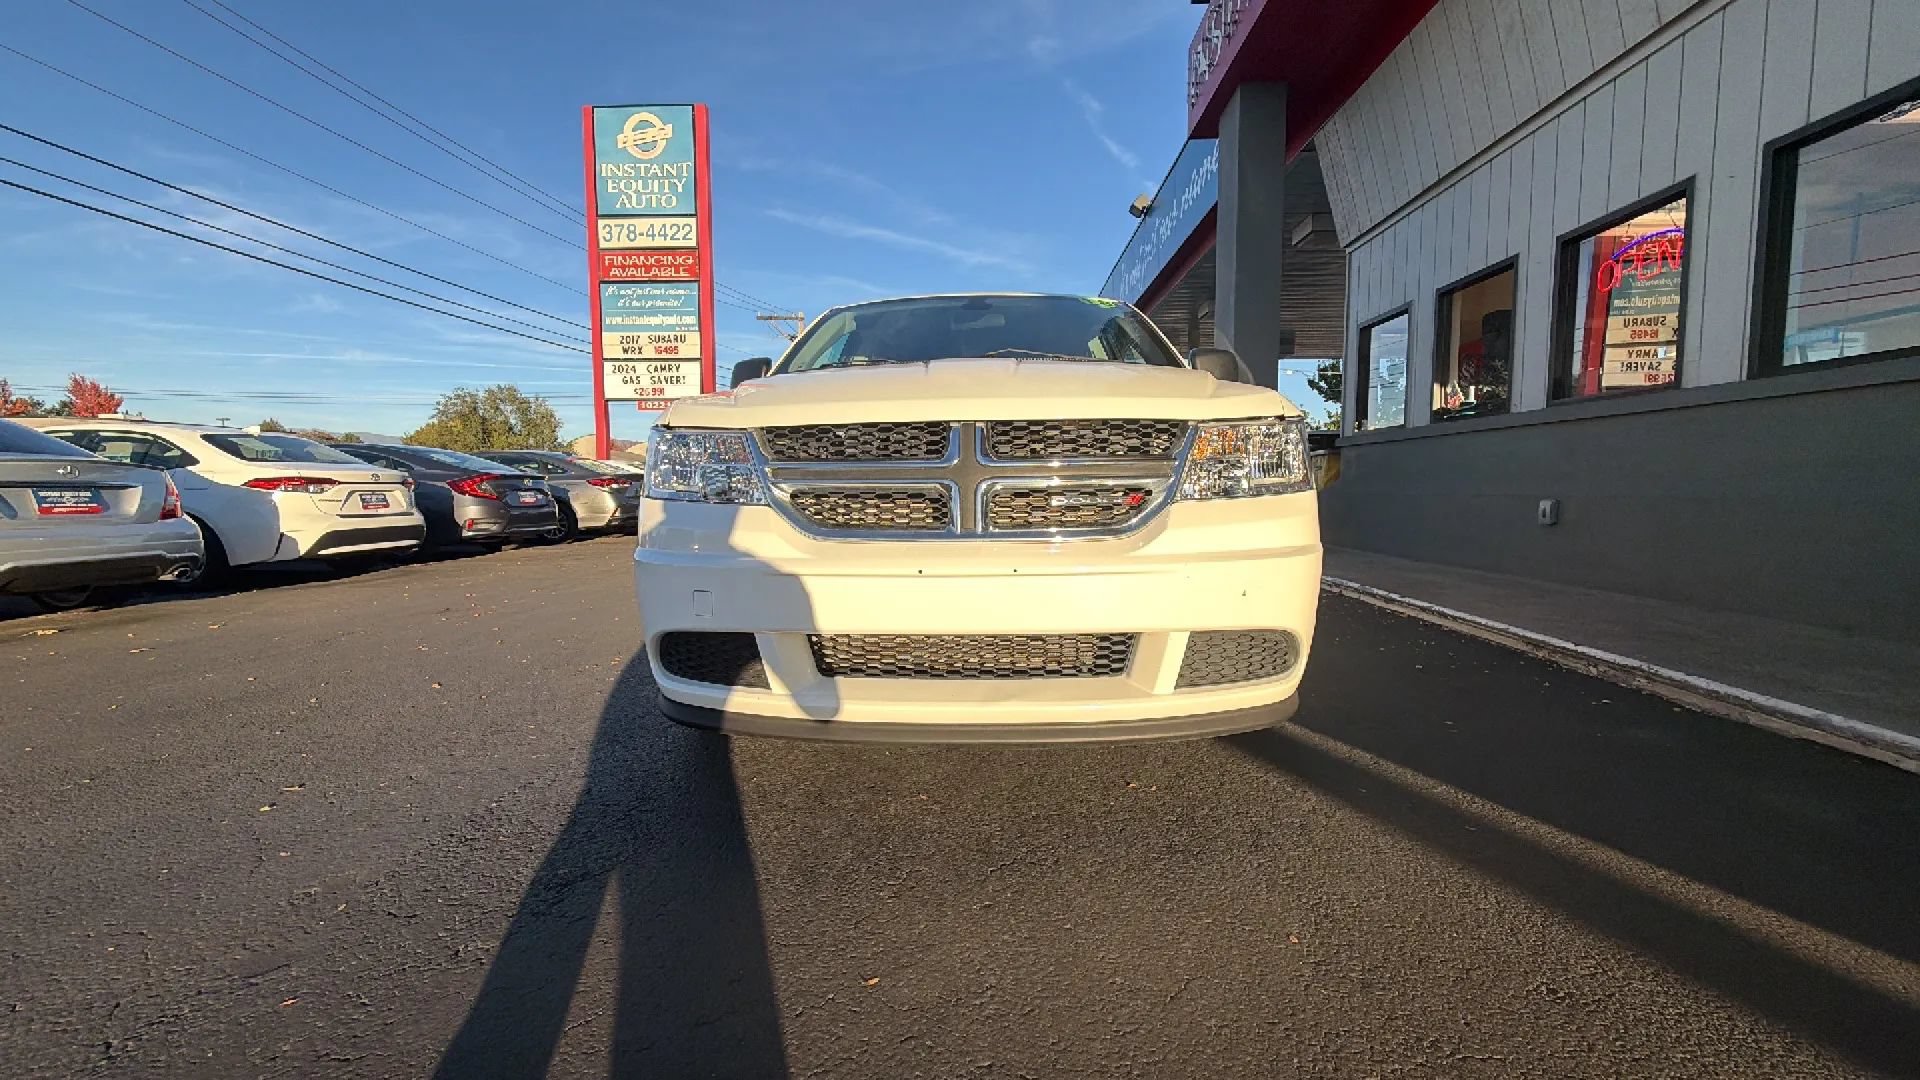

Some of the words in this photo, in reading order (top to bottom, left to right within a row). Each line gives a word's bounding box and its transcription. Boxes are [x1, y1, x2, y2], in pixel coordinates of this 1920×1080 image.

[600, 162, 692, 177] INSTANT
[606, 178, 686, 194] EQUITY
[615, 193, 677, 208] AUTO
[602, 223, 693, 242] 378-4422
[604, 255, 695, 266] FINANCING
[1598, 233, 1683, 292] OPEN
[609, 266, 691, 277] AVAILABLE
[619, 335, 641, 345] 2017
[648, 334, 686, 344] SUBARU
[622, 346, 643, 355] WRX
[654, 345, 679, 355] 16495
[611, 364, 637, 374] 2024
[646, 363, 681, 374] CAMRY
[622, 376, 641, 385] GAS
[650, 375, 686, 385] SAVER!
